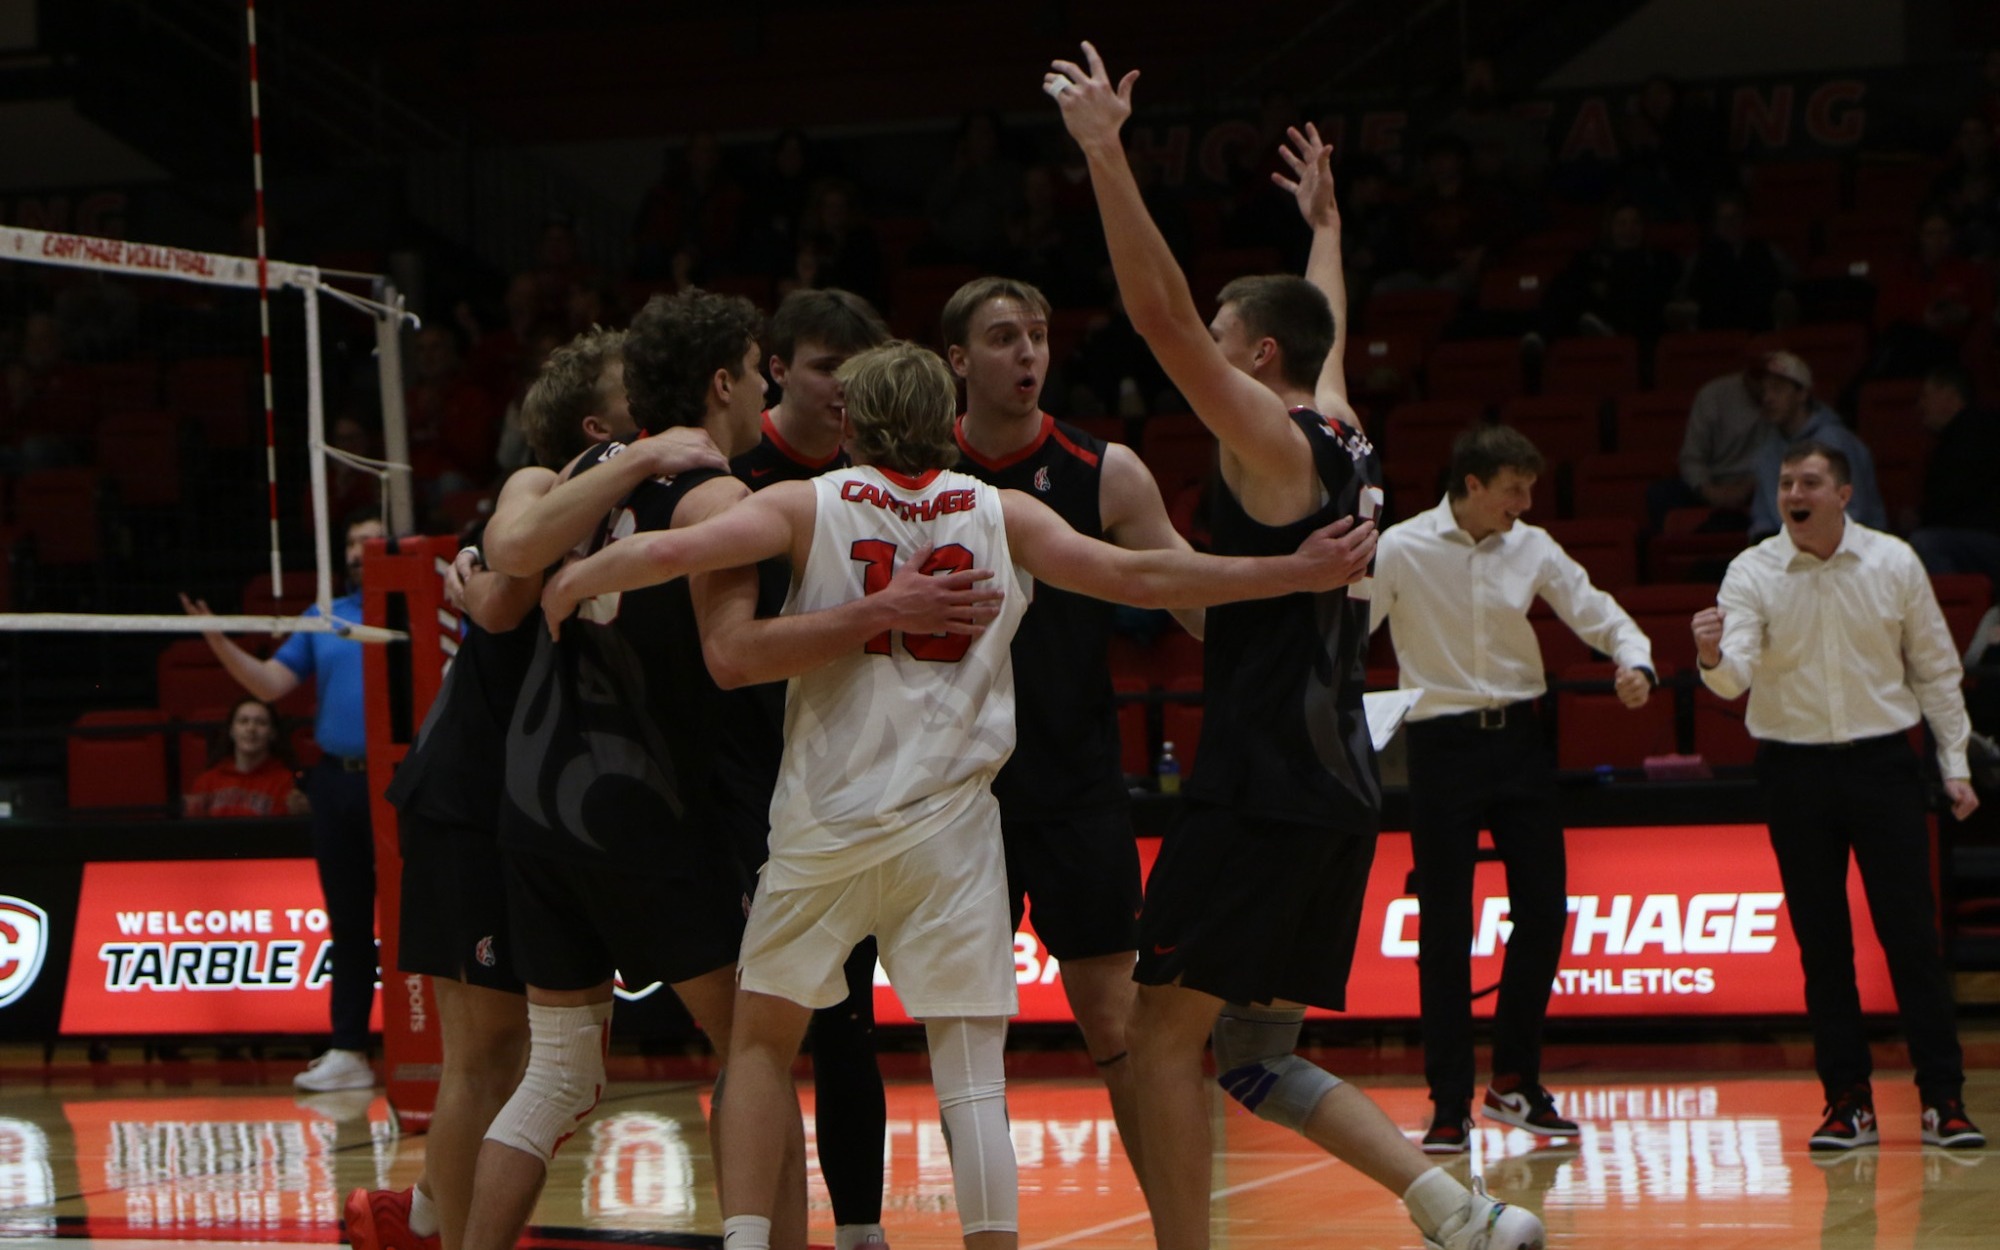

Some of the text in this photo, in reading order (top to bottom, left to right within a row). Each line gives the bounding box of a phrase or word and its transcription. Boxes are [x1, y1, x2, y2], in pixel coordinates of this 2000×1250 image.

[116, 909, 329, 935] WELCOME TO
[1380, 892, 1785, 958] CRHAGE
[99, 940, 302, 992] TARBLE
